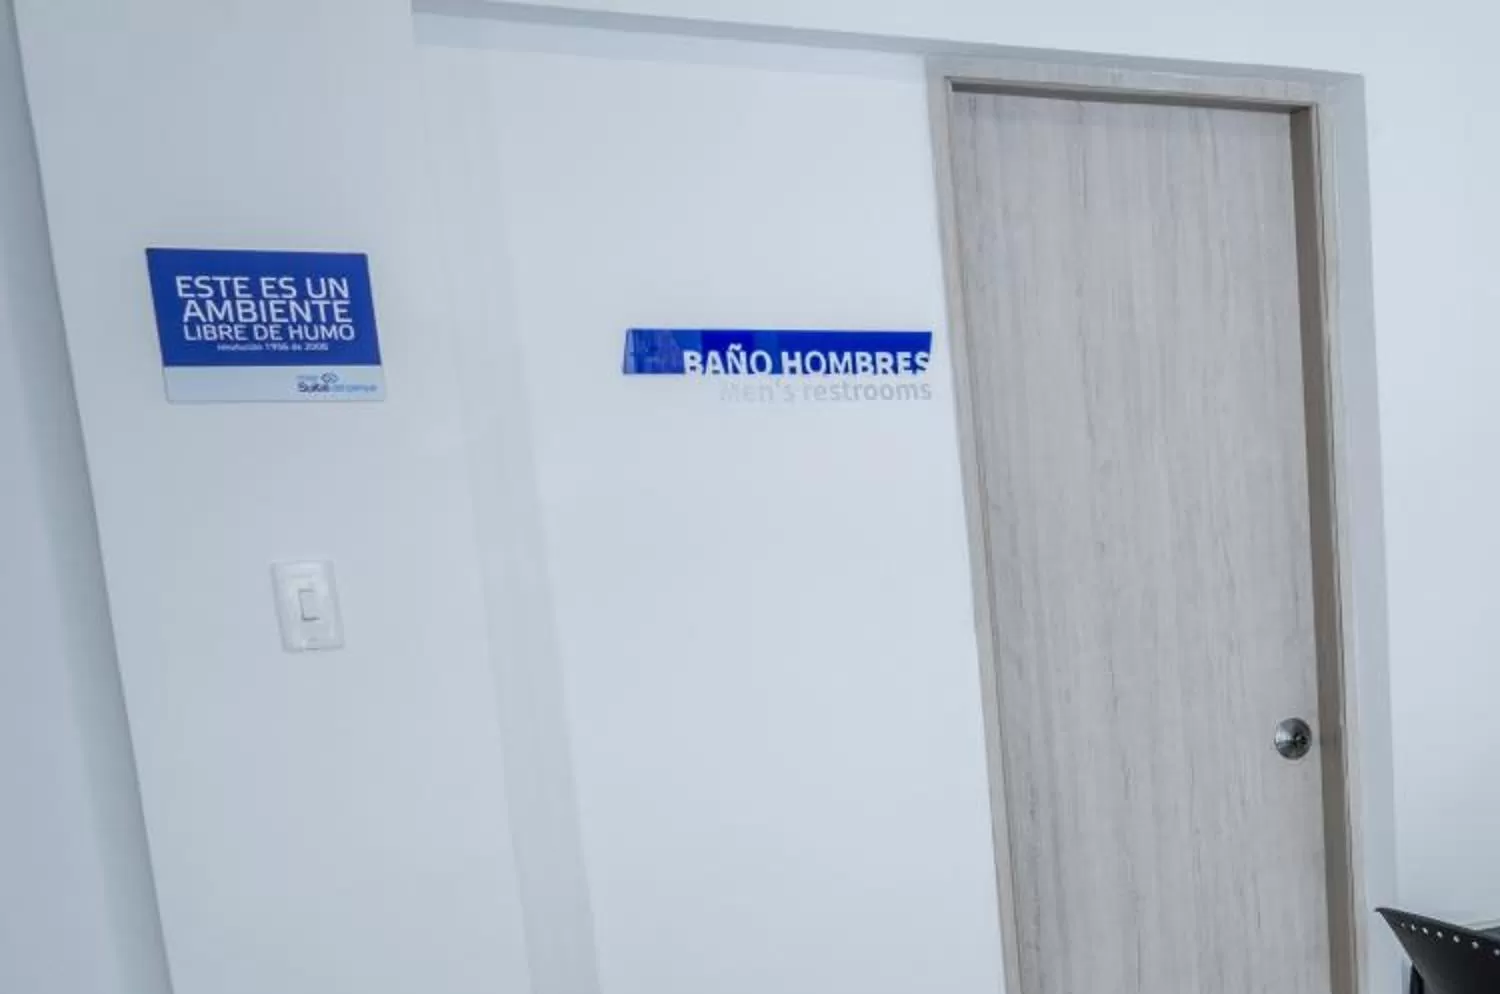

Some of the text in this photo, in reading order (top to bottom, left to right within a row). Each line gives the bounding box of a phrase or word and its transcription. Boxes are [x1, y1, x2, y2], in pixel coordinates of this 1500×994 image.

[175, 275, 349, 299] ESTE ES UN
[183, 299, 353, 323] AMBIENTE
[184, 324, 355, 341] LIBRE DE HUMO
[683, 343, 931, 376] BAÑO HOMBRES
[718, 380, 932, 402] Men's restrooms
